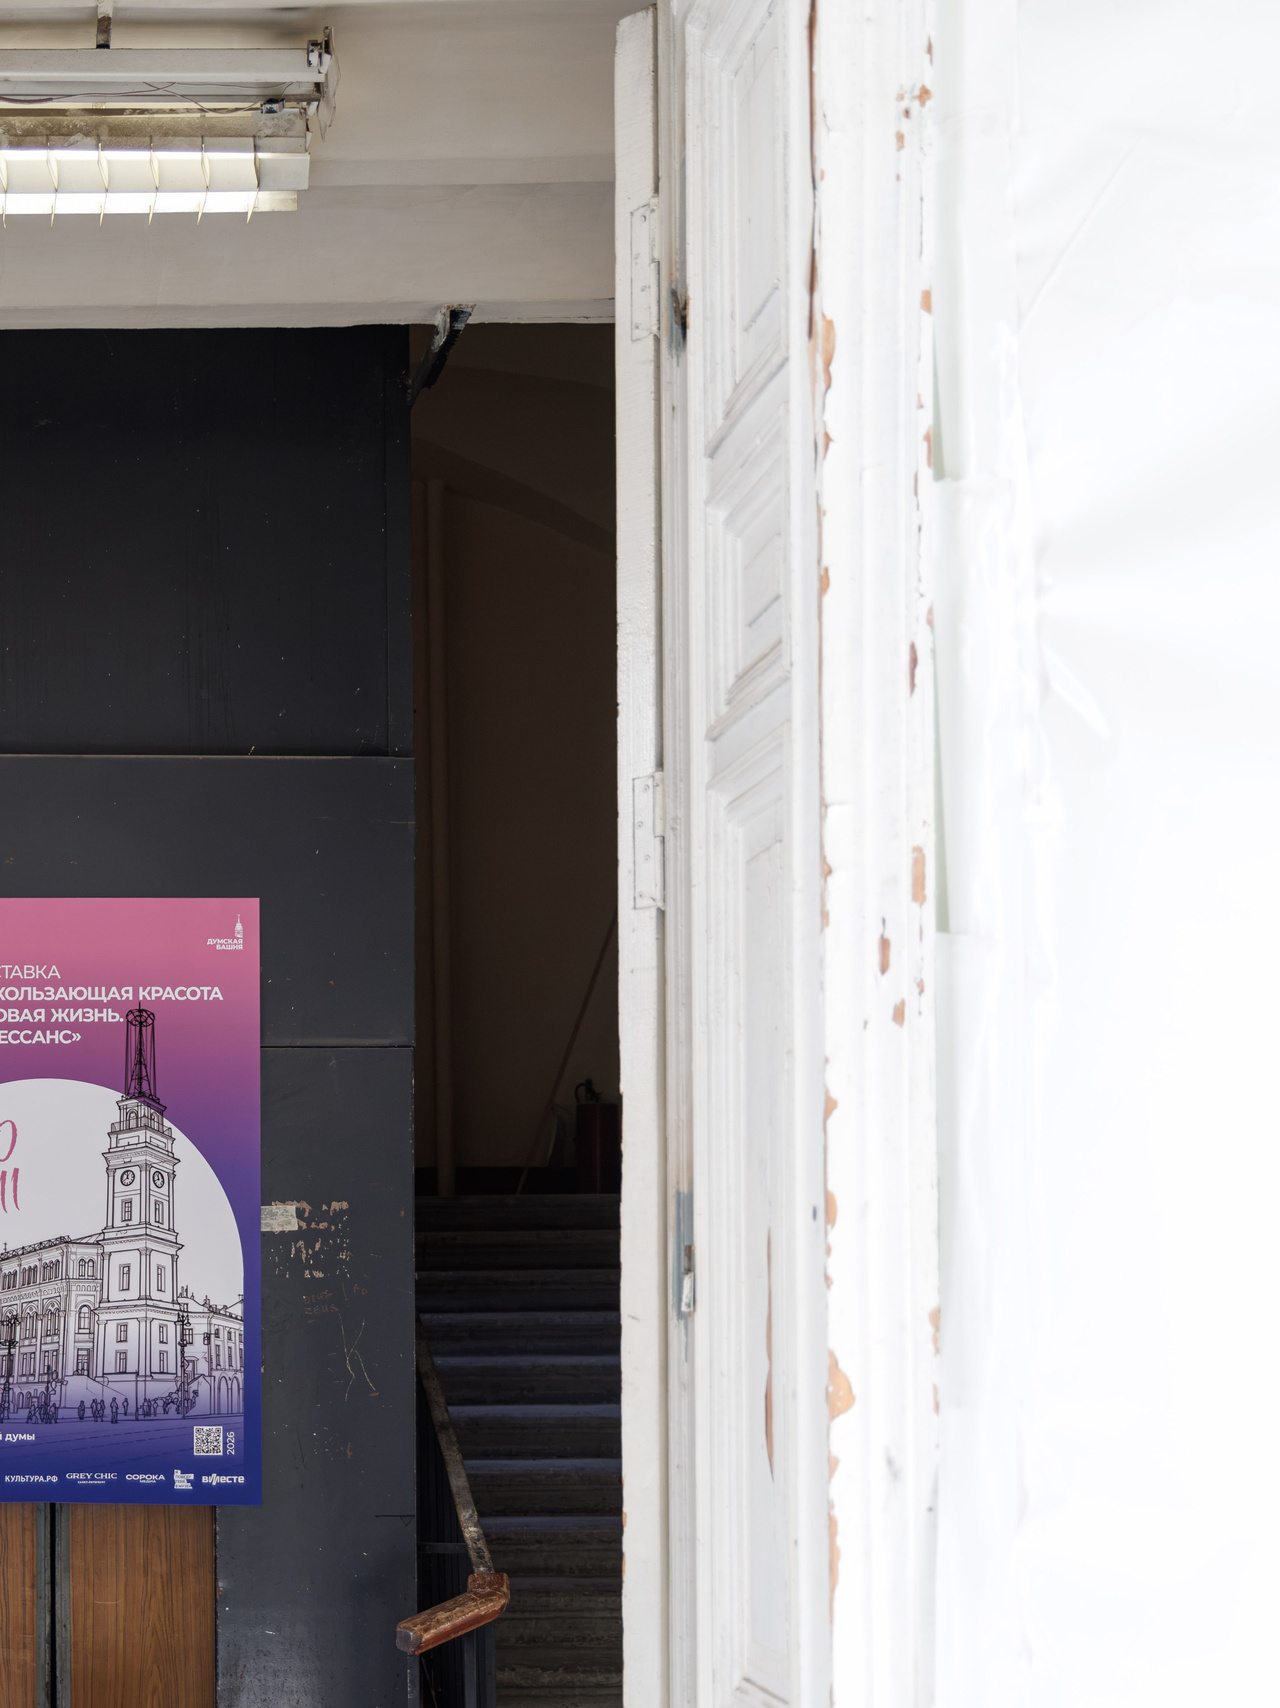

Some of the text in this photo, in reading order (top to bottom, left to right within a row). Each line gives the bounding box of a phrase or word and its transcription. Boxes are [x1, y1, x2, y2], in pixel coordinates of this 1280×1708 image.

[138, 986, 224, 1001] КРАСОТА
[50, 1008, 124, 1022] ЖИЗНЬ.
[5, 1433, 36, 1442] думы
[226, 1431, 235, 1455] 2026
